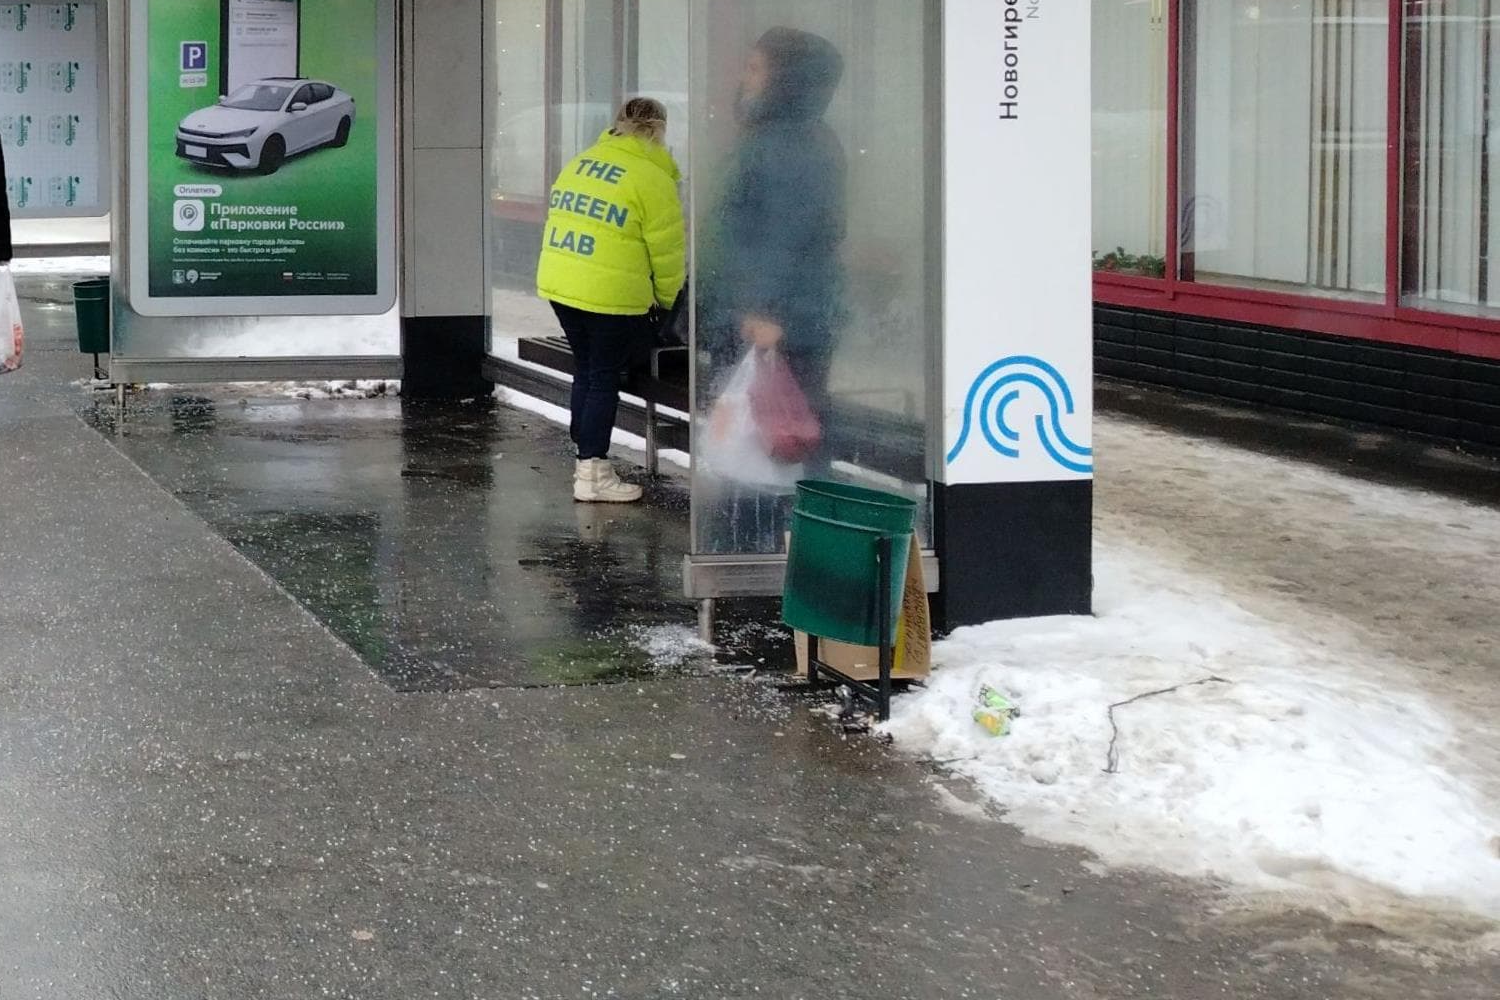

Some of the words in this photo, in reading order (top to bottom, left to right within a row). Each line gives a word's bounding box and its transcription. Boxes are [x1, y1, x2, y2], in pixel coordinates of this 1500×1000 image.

[188, 46, 202, 68] P
[575, 159, 627, 185] THE
[210, 203, 298, 217] Приложение
[549, 189, 629, 228] GREEN
[210, 218, 286, 233] «Парковки
[289, 218, 346, 231] России»
[548, 226, 596, 256] LAB
